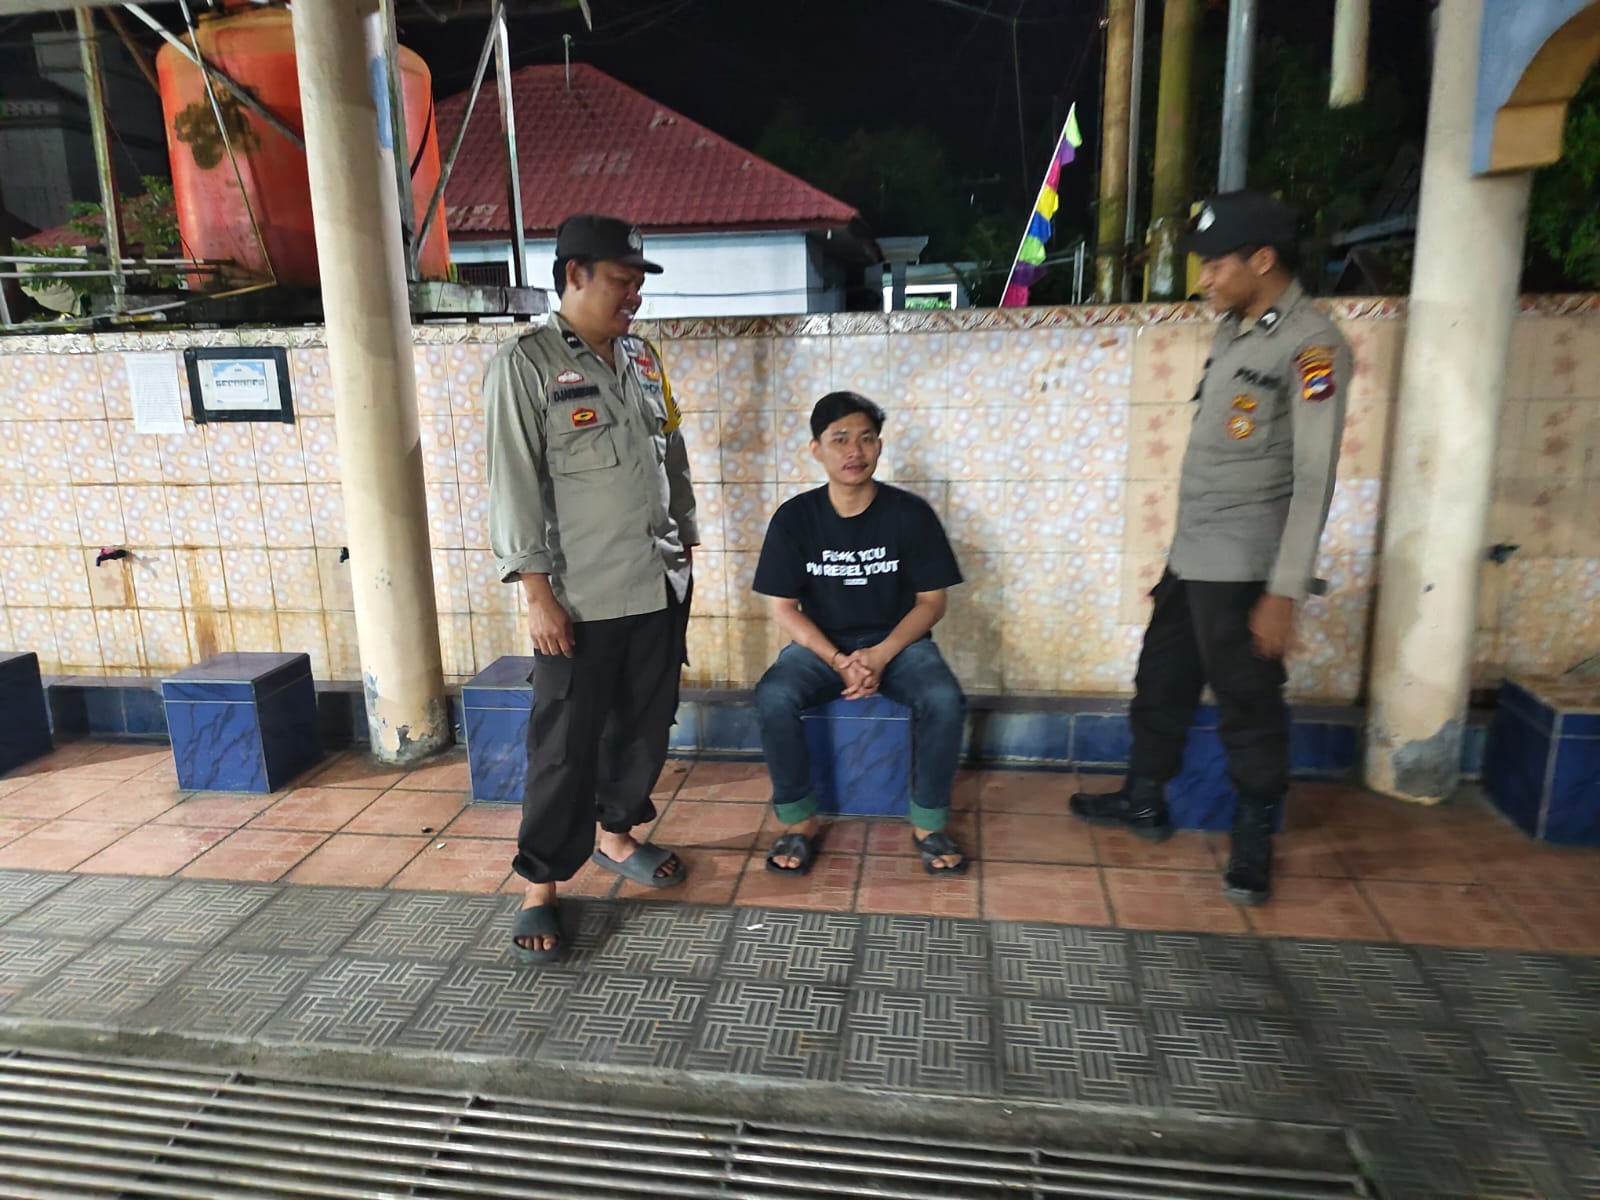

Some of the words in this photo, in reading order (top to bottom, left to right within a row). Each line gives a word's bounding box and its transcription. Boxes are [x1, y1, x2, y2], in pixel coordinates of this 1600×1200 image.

[857, 547, 886, 562] YOU
[823, 564, 863, 576] REBEL
[863, 560, 900, 576] YOUT
